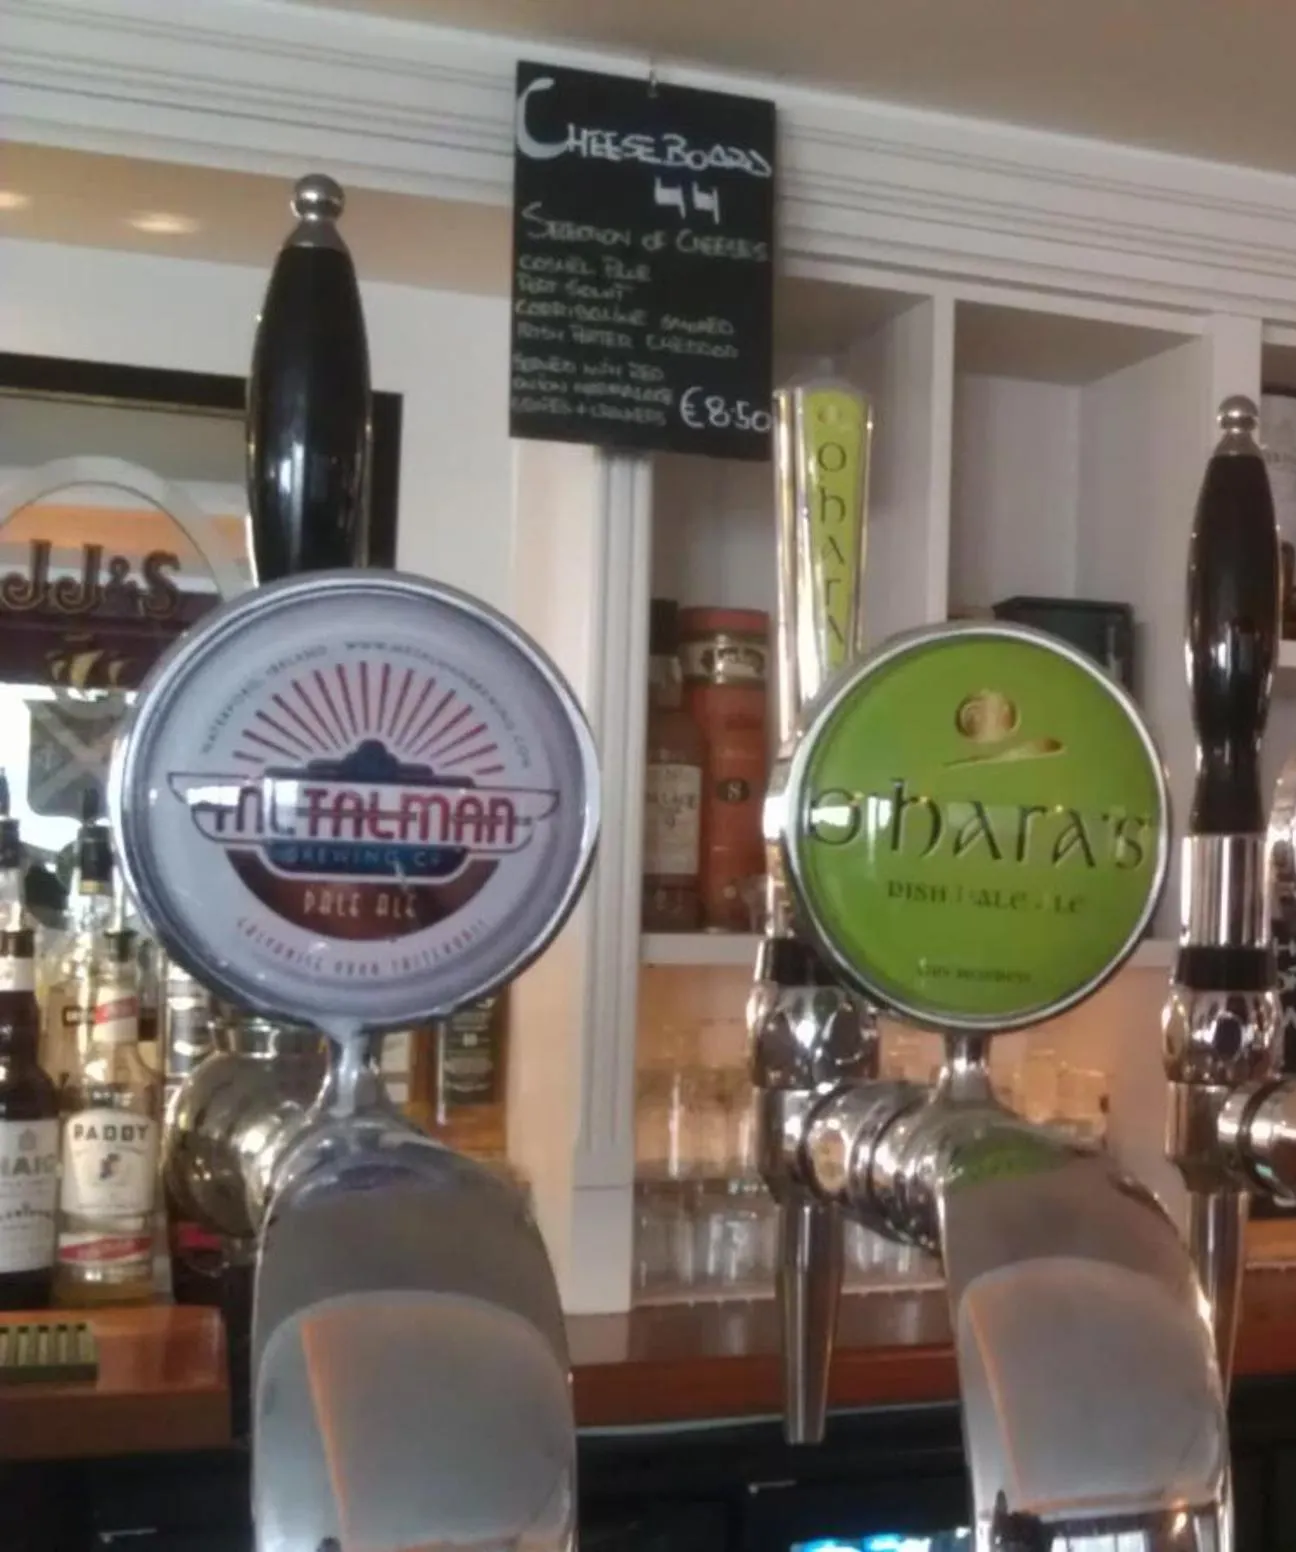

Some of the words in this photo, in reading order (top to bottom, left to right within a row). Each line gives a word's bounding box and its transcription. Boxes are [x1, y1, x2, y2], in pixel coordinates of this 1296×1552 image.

[303, 888, 359, 917] PALE
[375, 891, 418, 919] ALE
[73, 1123, 149, 1142] PADDY
